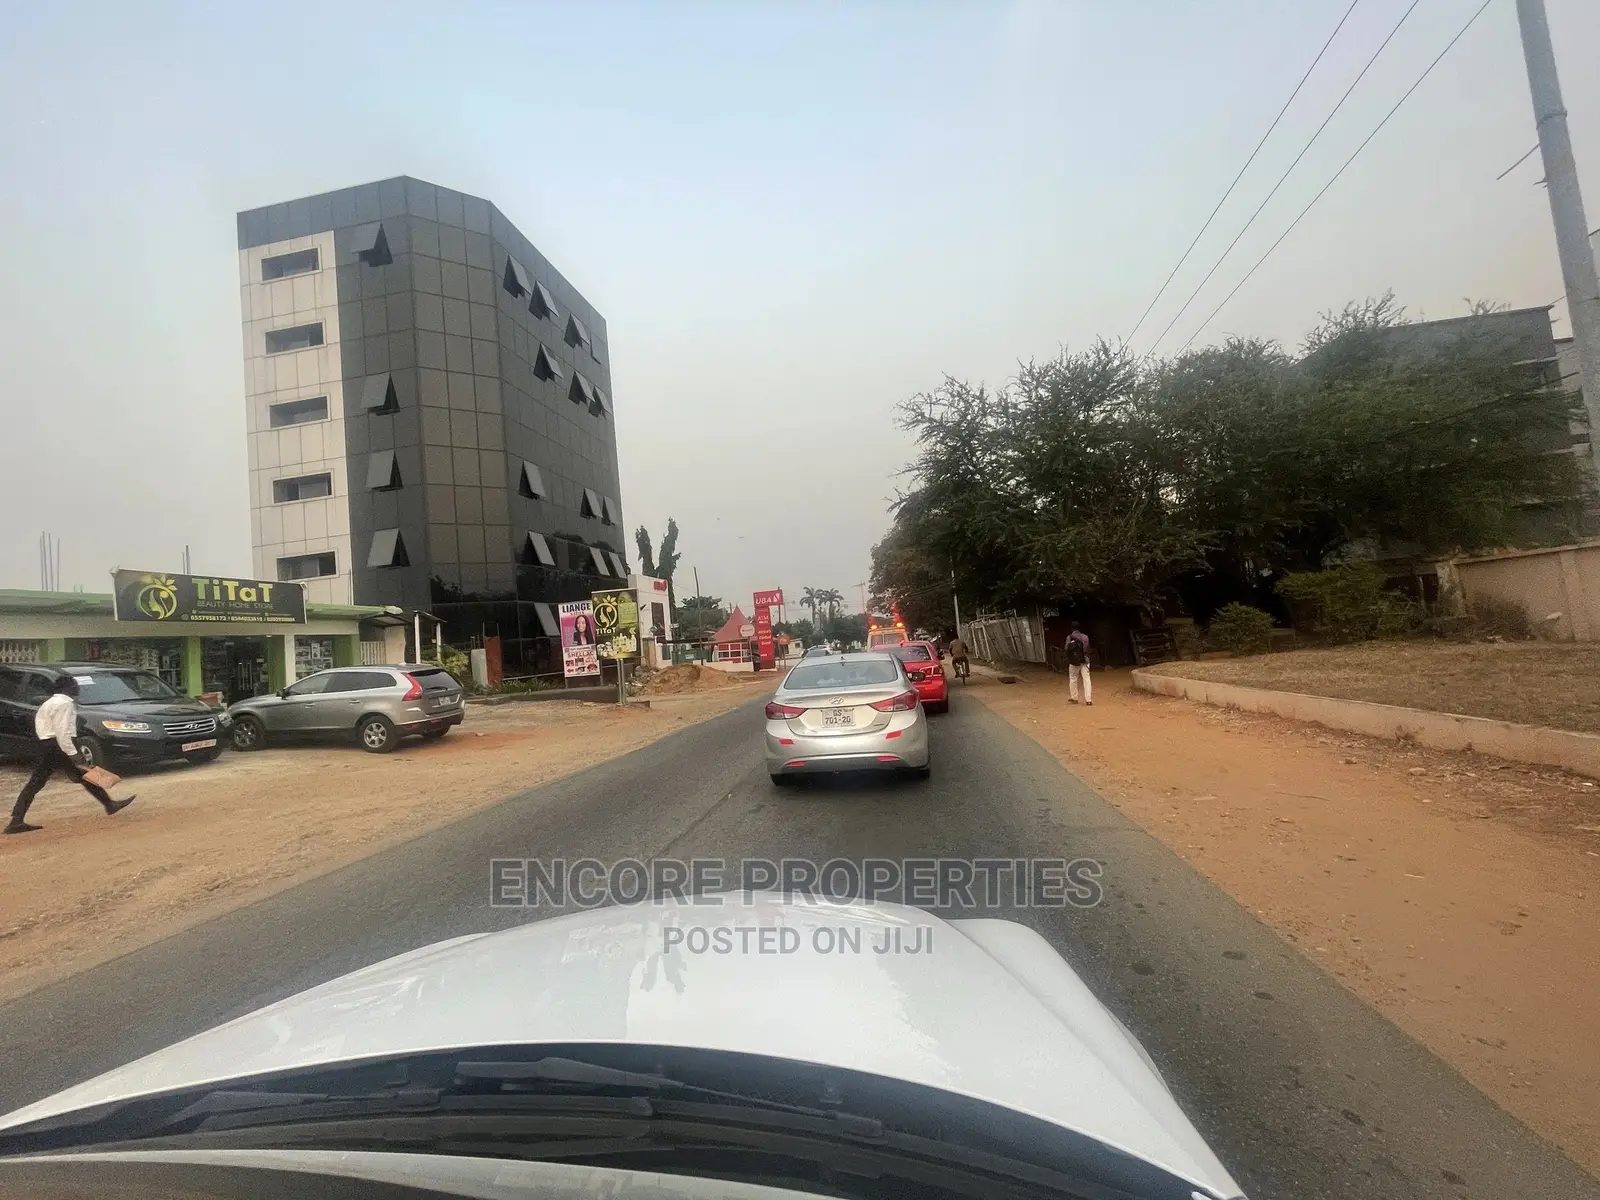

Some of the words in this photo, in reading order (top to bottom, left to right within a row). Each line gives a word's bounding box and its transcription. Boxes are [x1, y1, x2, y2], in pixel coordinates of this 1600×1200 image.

[192, 578, 273, 602] TiTaT
[756, 596, 772, 604] UBA
[197, 601, 225, 609] BEAUTY
[562, 603, 591, 613] LIANGE
[825, 716, 851, 725] 701-20
